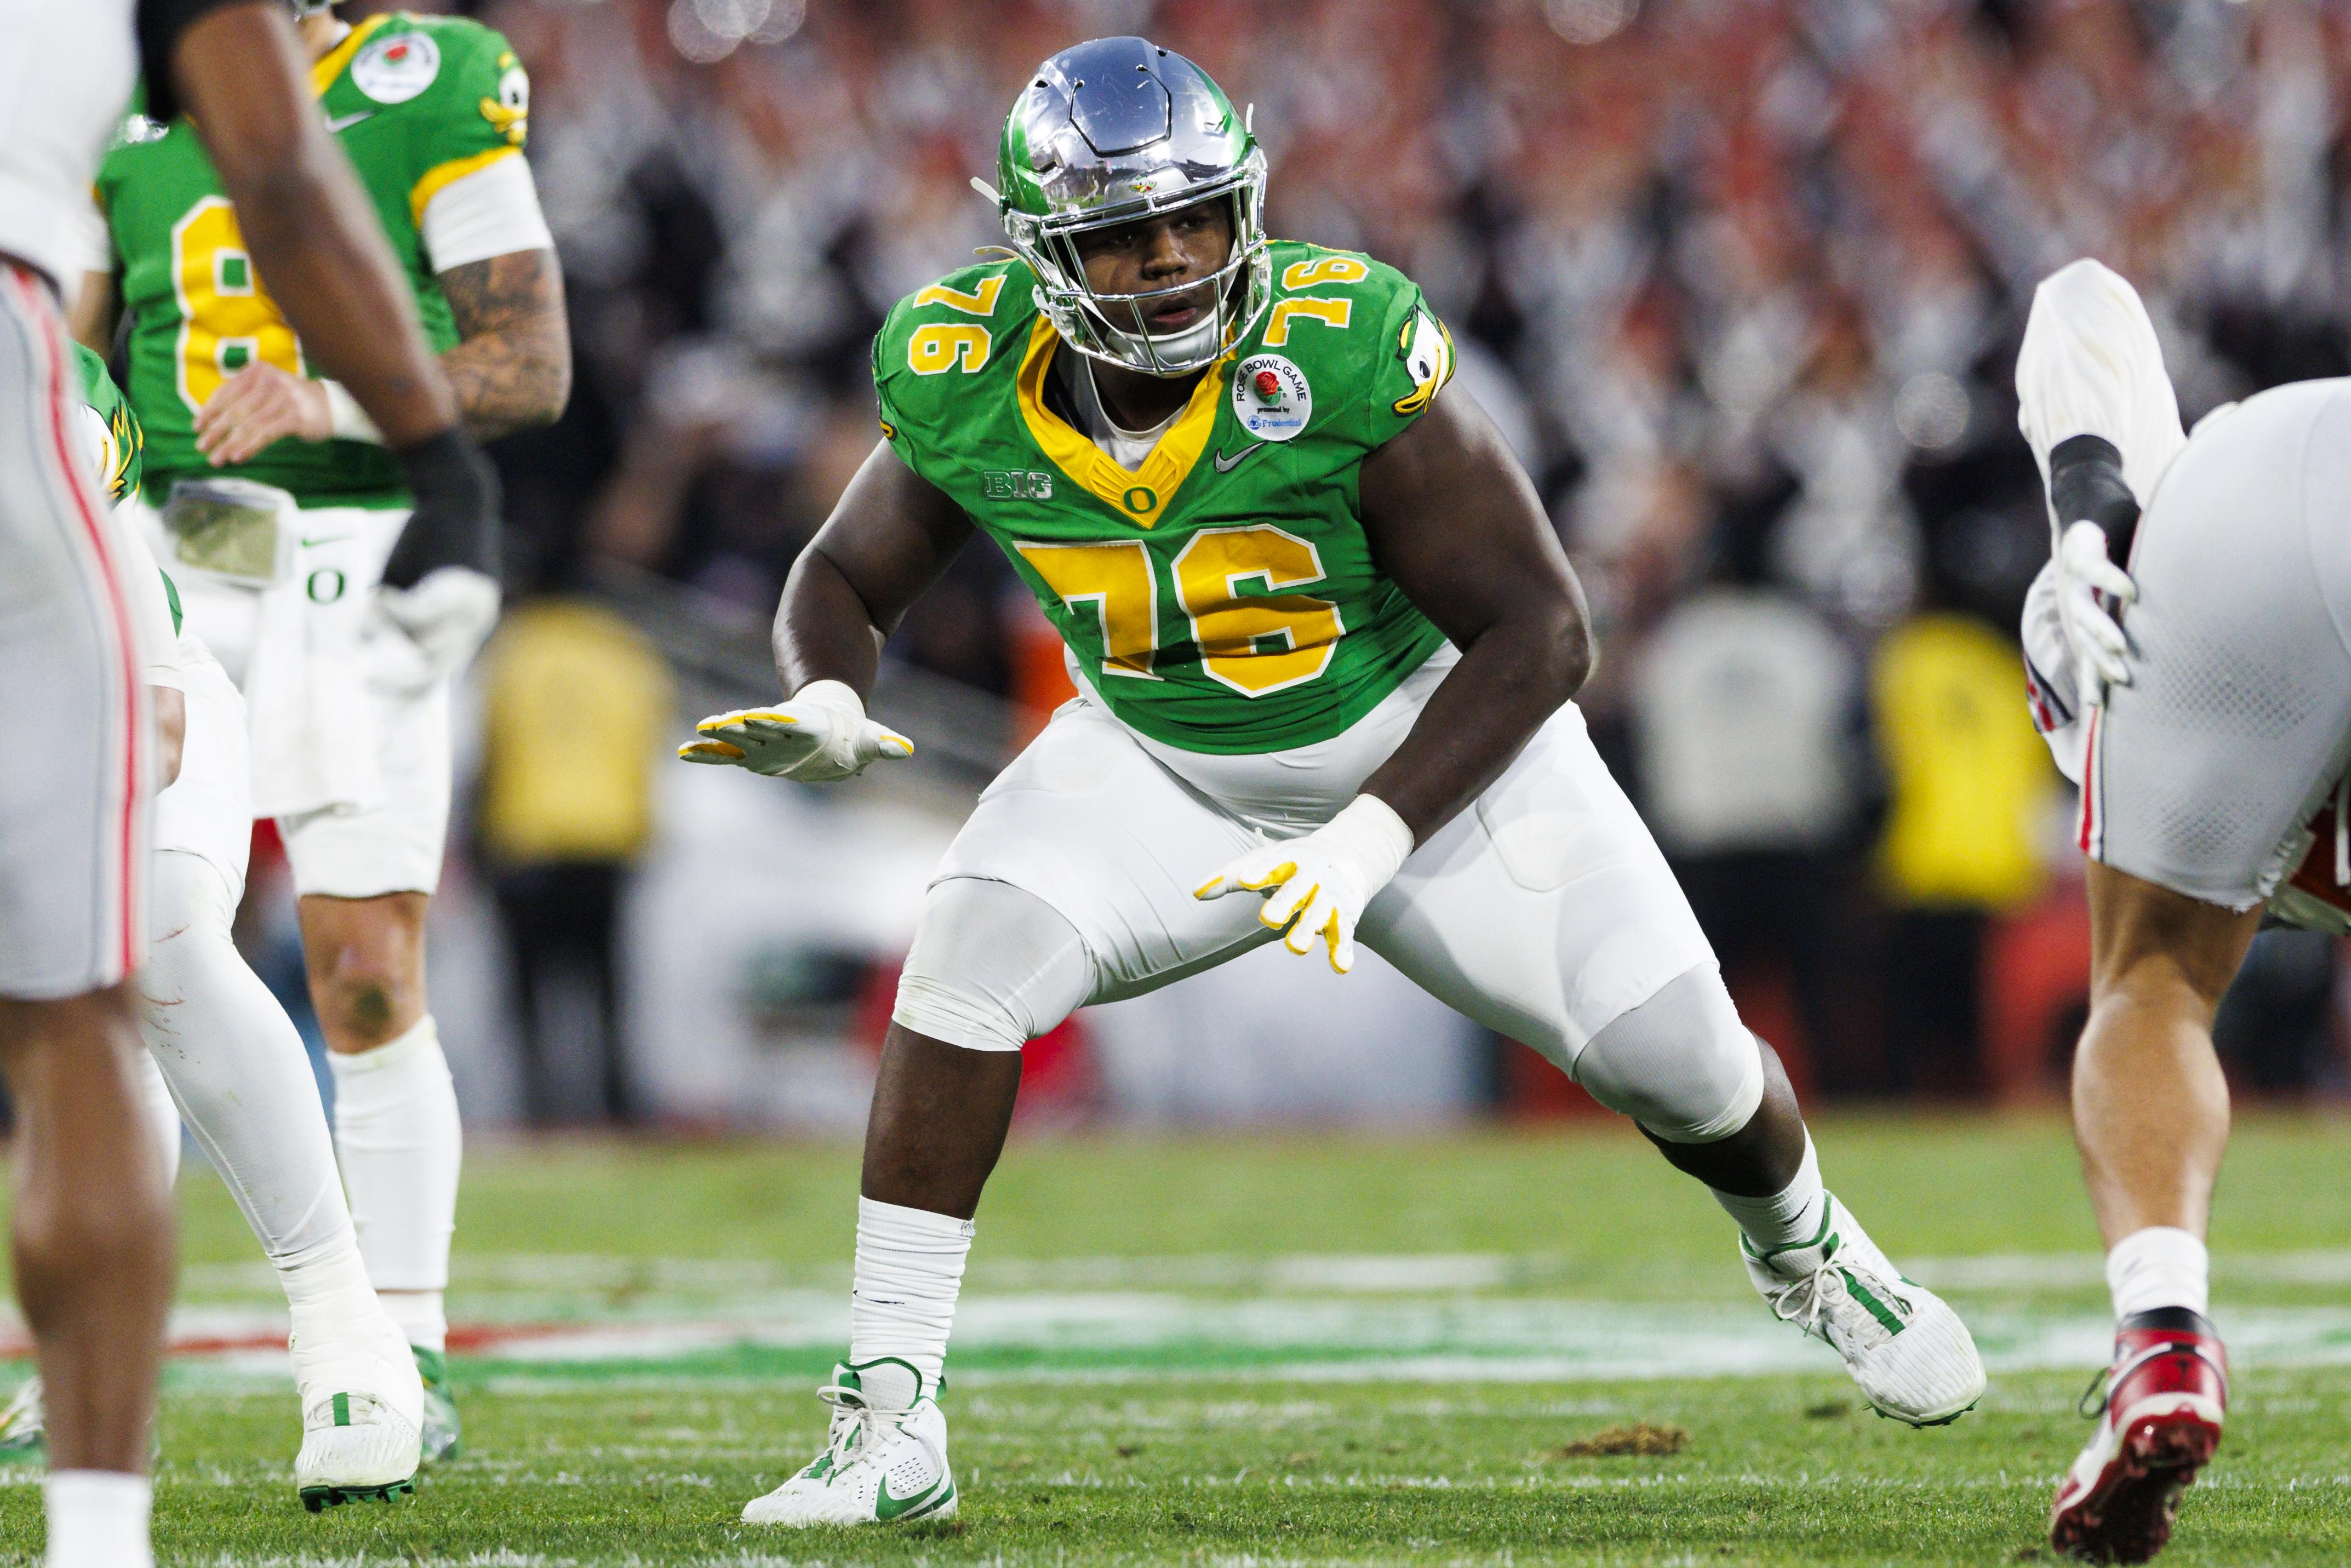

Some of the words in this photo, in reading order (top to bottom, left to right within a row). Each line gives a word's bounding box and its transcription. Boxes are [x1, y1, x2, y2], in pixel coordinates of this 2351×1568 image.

[907, 274, 1008, 376] 76
[1262, 257, 1370, 347] 76
[1236, 370, 1248, 402] ROSE
[1245, 359, 1282, 373] BOWL
[1283, 366, 1307, 402] GAME
[1262, 419, 1302, 428] Prudential
[1123, 486, 1158, 514] O
[1012, 524, 1346, 699] 76
